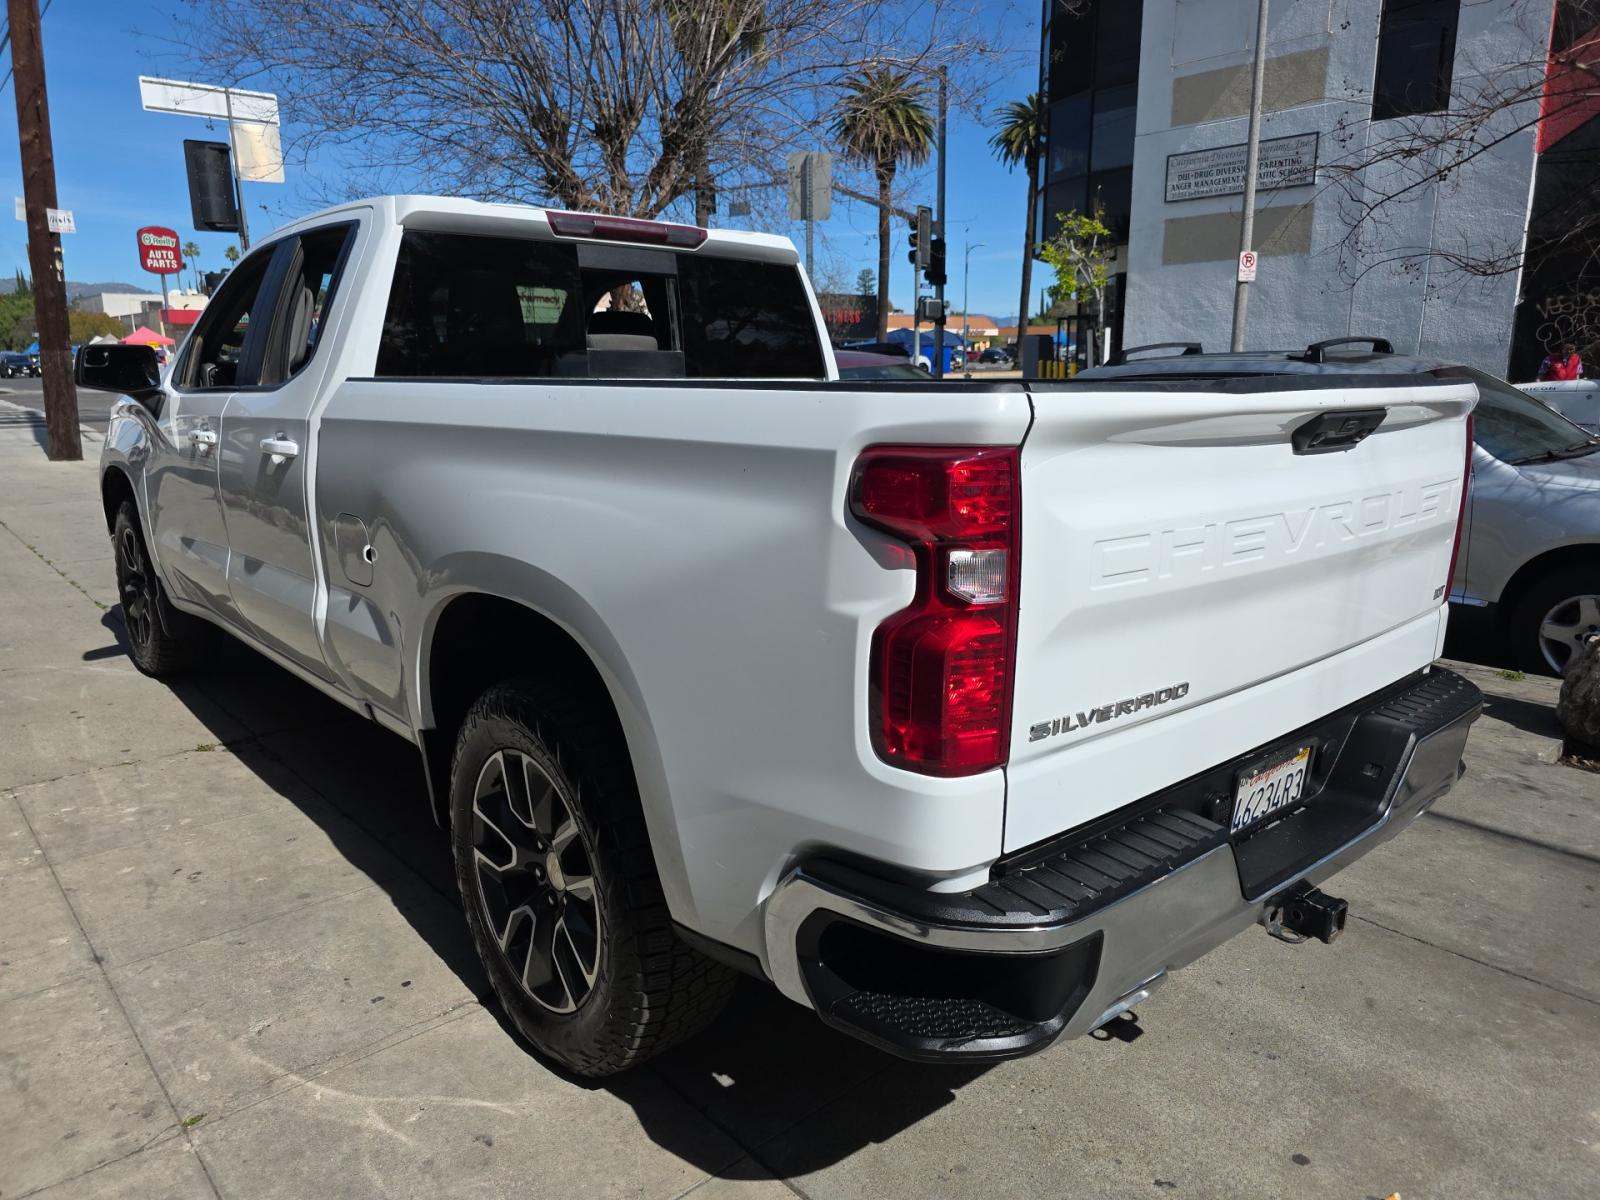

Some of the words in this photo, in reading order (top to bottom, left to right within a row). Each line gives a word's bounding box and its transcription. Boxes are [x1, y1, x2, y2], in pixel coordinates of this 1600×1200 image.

[1260, 157, 1302, 169] PARENTING
[1171, 182, 1192, 191] ANGER
[1195, 175, 1242, 188] MANAGEMENT
[150, 250, 174, 260] AUTO
[147, 259, 178, 269] PARTS
[1091, 479, 1461, 592] CHEVROLET
[1029, 681, 1190, 742] SILVERADO
[1231, 768, 1304, 830] 46234R3
